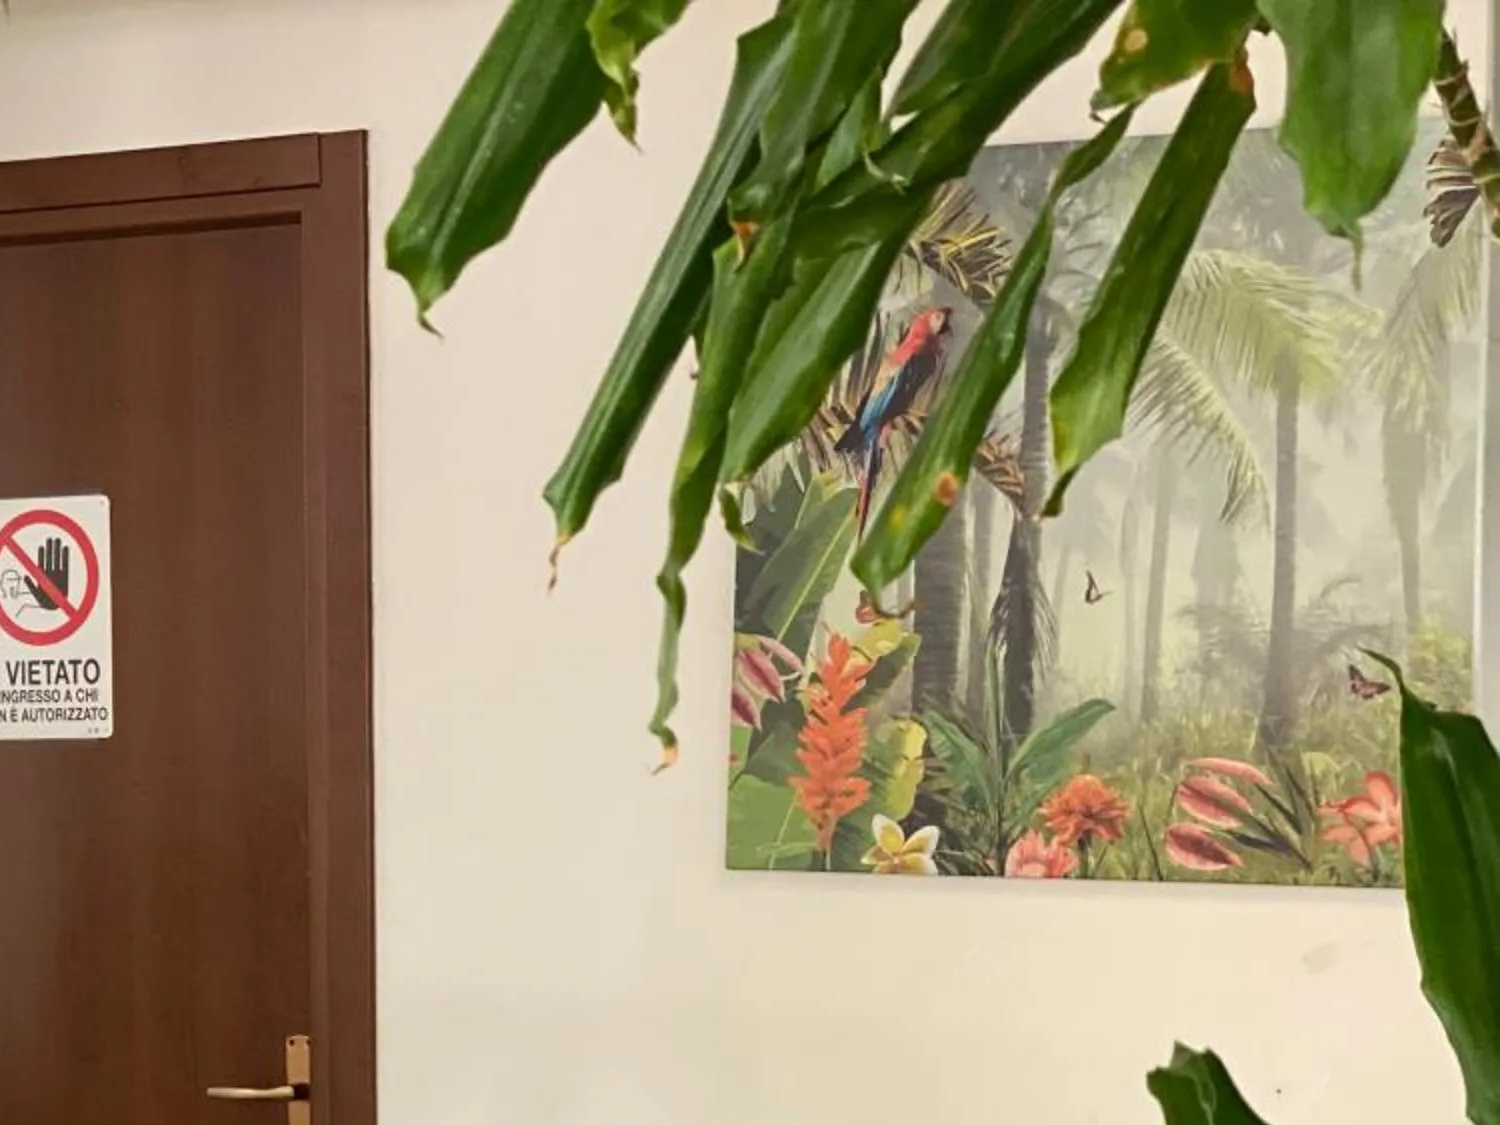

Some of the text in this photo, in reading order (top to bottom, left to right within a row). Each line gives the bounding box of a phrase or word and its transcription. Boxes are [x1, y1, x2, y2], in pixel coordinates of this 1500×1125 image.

[5, 658, 101, 686] VIETATO
[63, 688, 74, 703] A
[75, 687, 99, 703] CHI
[21, 706, 109, 723] AUTORIZZATO
